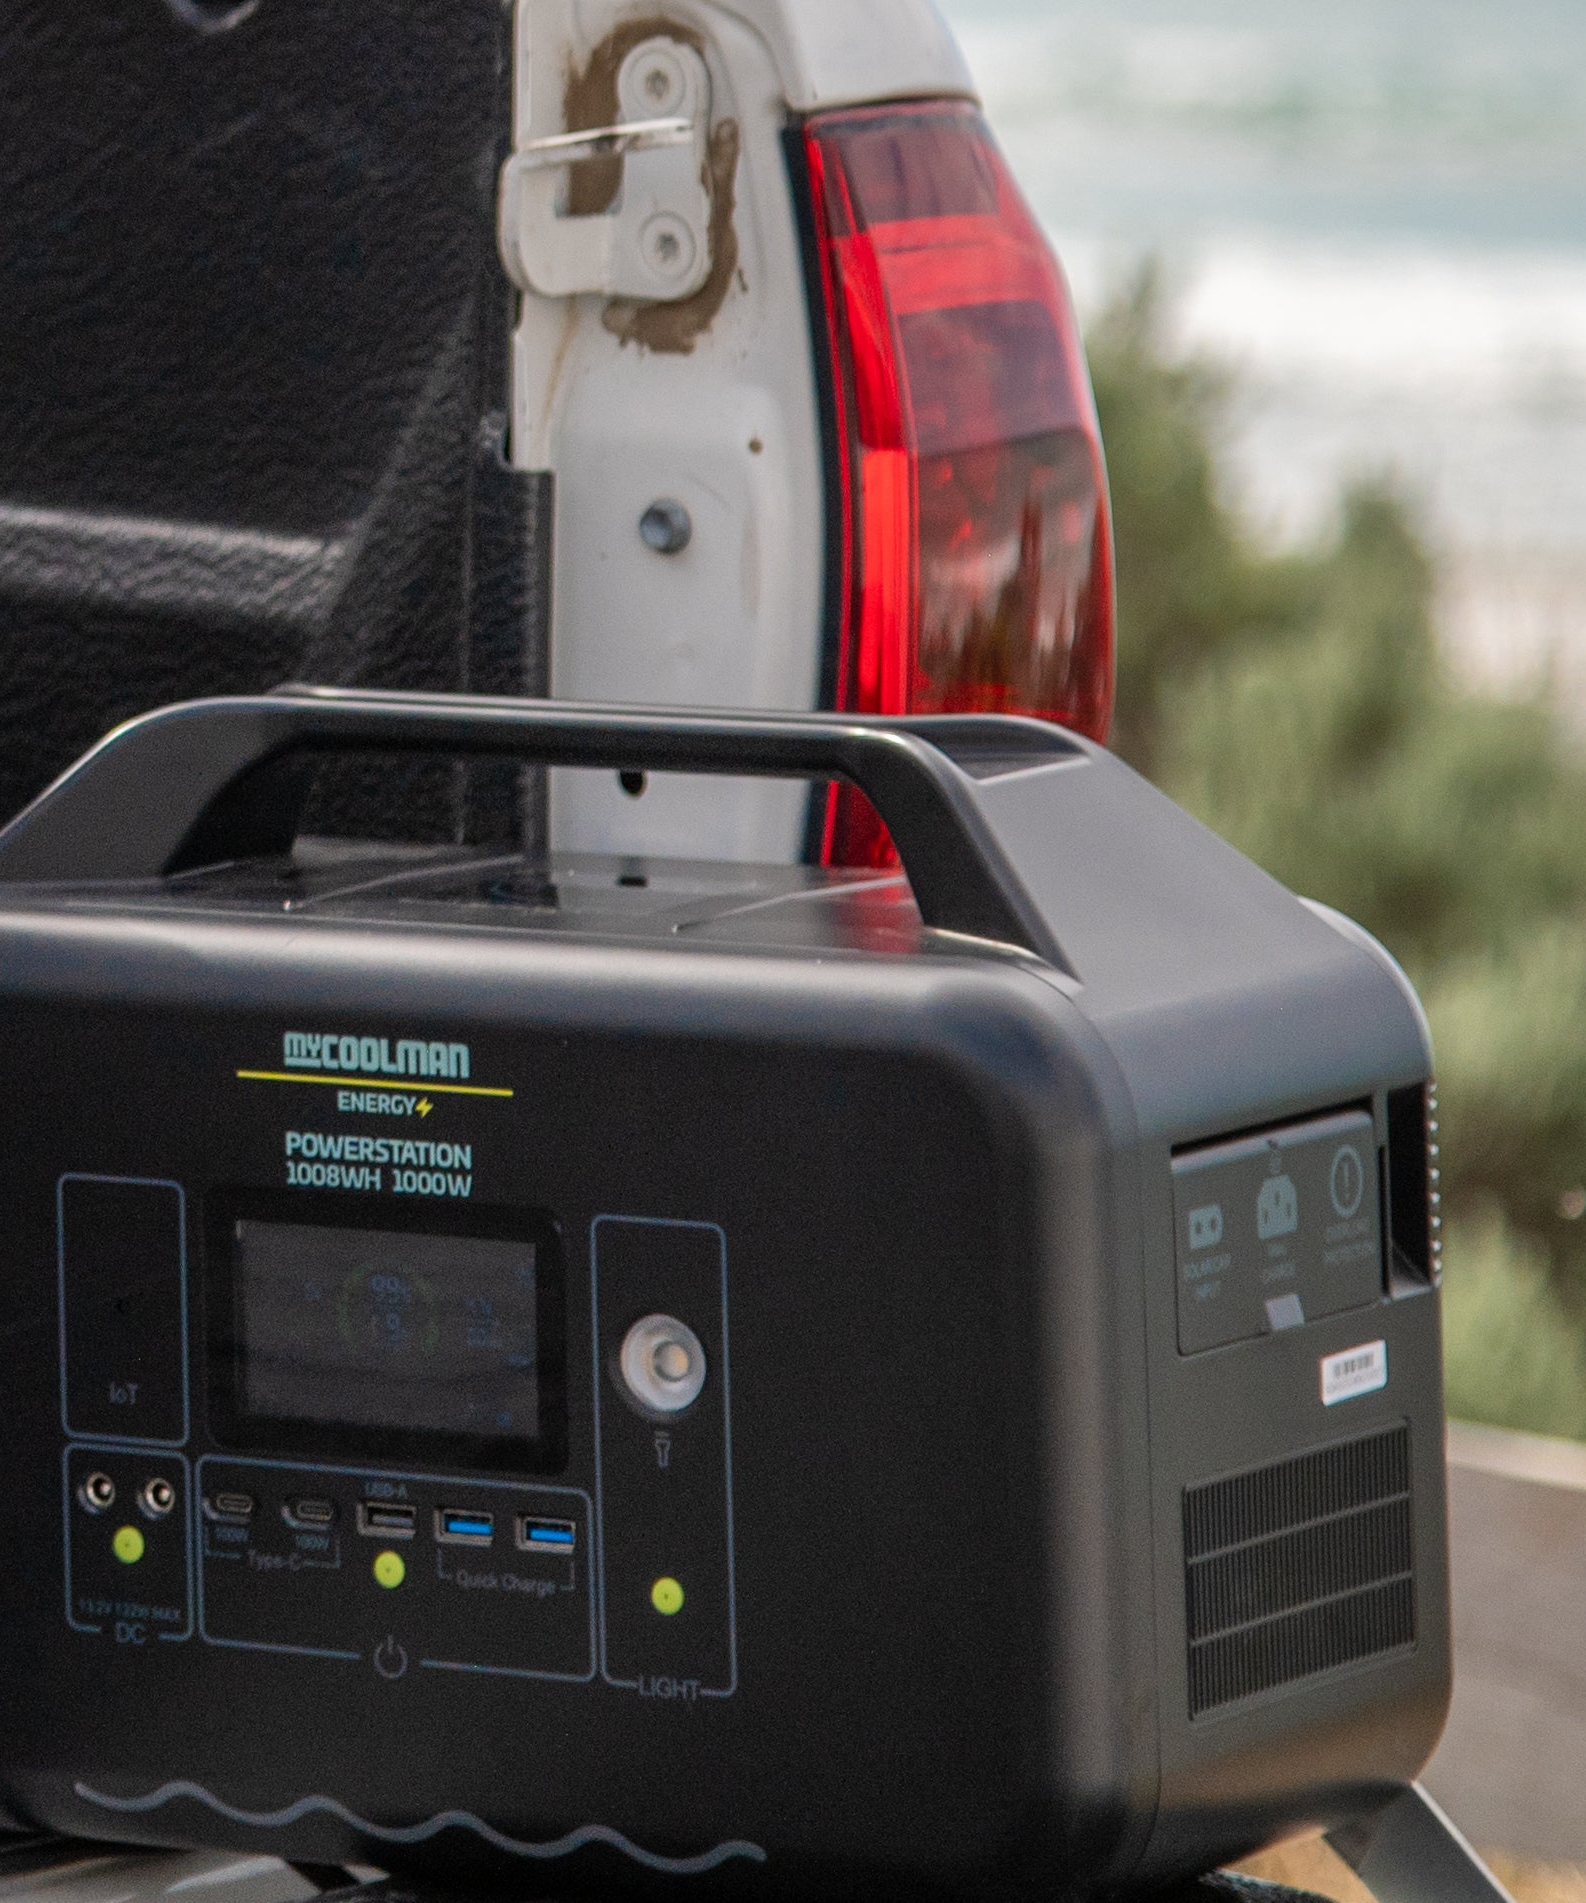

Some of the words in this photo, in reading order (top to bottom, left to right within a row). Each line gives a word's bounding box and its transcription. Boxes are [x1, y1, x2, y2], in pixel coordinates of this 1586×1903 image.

[283, 1031, 470, 1079] MYCOOLMAN
[338, 1090, 416, 1116] ENERGY
[286, 1131, 472, 1171] POWERSTATION
[286, 1161, 381, 1192] 1008WH
[393, 1168, 472, 1198] 1000W
[109, 1382, 138, 1405] IoT
[248, 1549, 302, 1572] Type-C
[456, 1570, 498, 1590] Quick
[502, 1572, 556, 1597] Charge
[114, 1620, 146, 1645] DC
[639, 1673, 702, 1702] LIGHT
